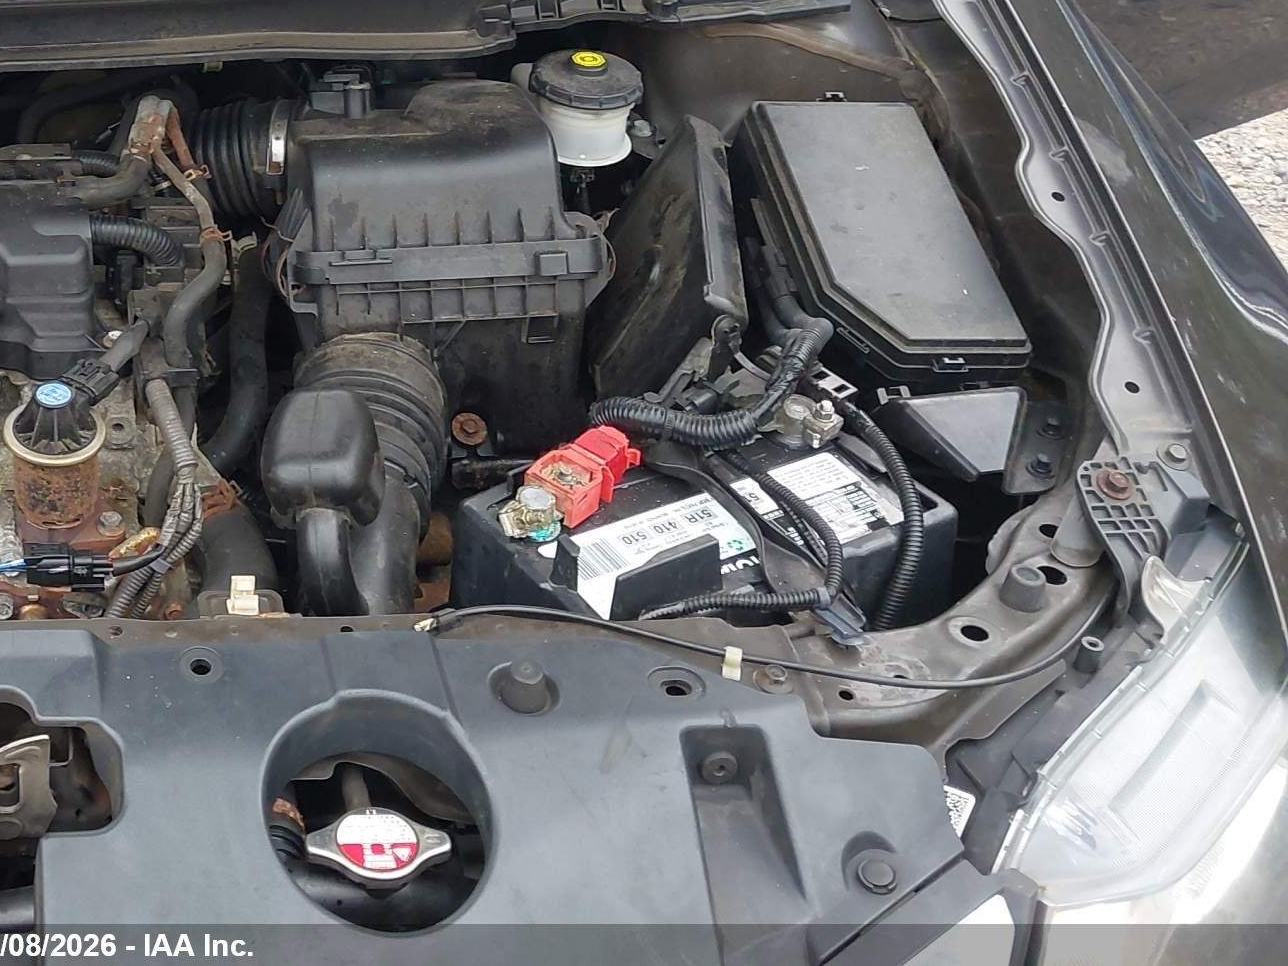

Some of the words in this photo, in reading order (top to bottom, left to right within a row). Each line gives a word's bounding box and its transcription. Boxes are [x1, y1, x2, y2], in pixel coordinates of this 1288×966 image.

[684, 509, 713, 524] 51R
[653, 520, 678, 534] 410
[623, 531, 647, 545] 510
